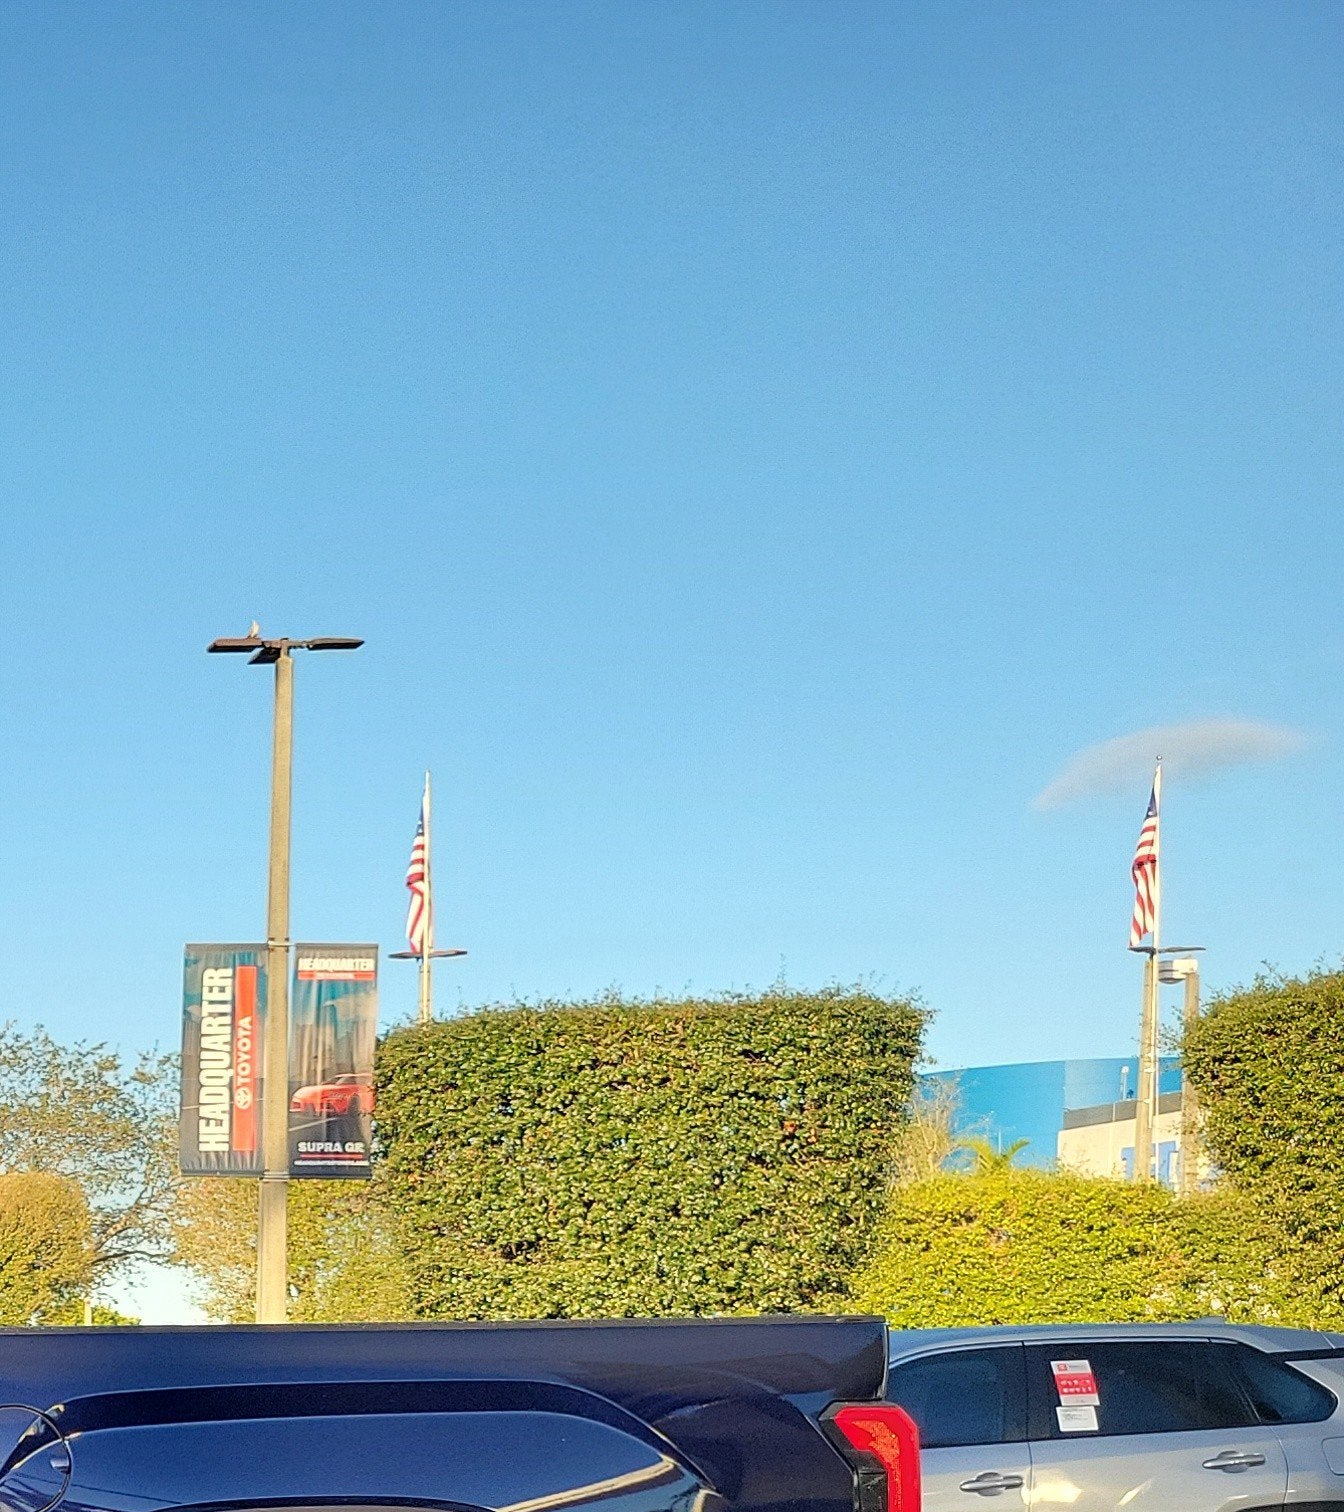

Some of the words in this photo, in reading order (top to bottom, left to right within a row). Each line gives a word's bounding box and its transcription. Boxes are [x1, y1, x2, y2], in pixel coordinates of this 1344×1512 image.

[199, 968, 234, 1152] HEADQUARTER
[237, 1016, 253, 1086] TOYOTA
[297, 1141, 343, 1153] SUPRA
[344, 1141, 366, 1153] GR
